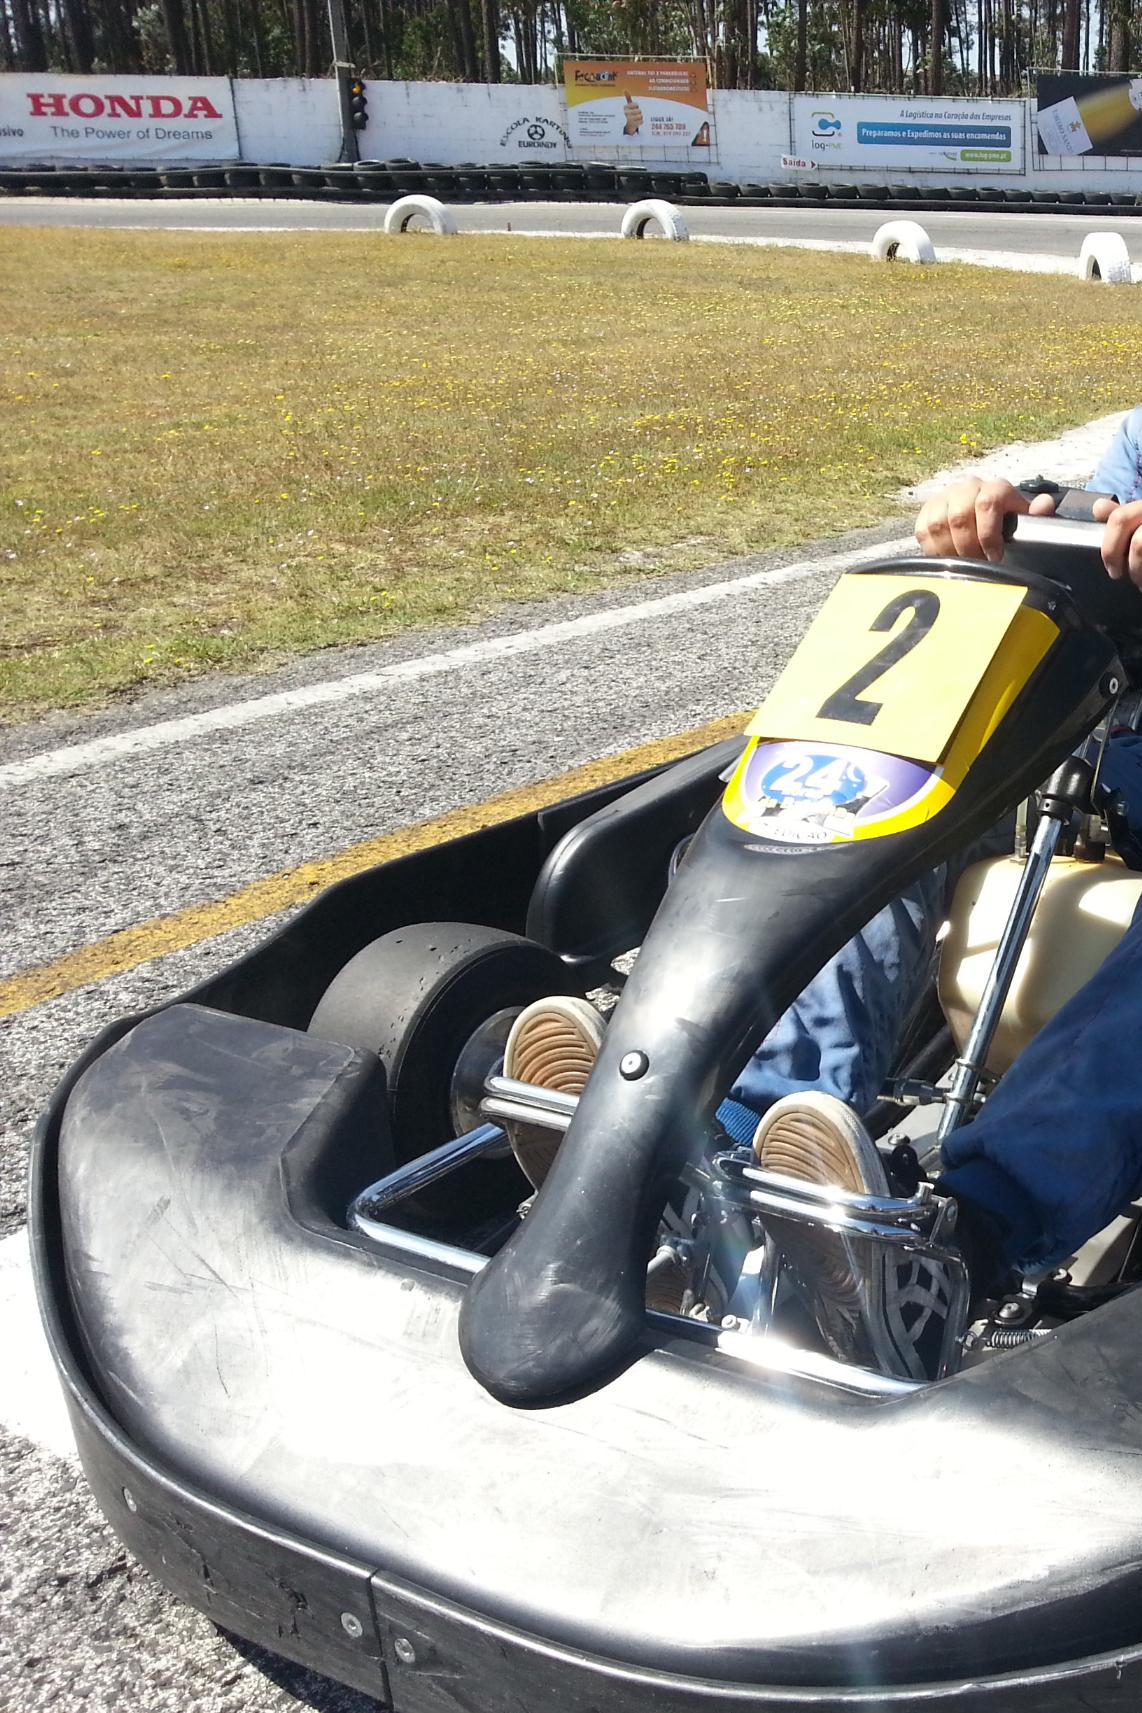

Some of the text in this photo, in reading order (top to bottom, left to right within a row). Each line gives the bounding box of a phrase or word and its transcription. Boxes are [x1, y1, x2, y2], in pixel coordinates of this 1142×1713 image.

[27, 93, 223, 118] HONDA
[51, 126, 79, 138] The
[85, 127, 131, 140] Power
[136, 127, 151, 140] of
[155, 127, 213, 140] Dreams
[500, 117, 530, 147] ESCOLA
[862, 128, 901, 138] Preparamos
[907, 129, 941, 139] Expedimos
[815, 589, 941, 726] 2
